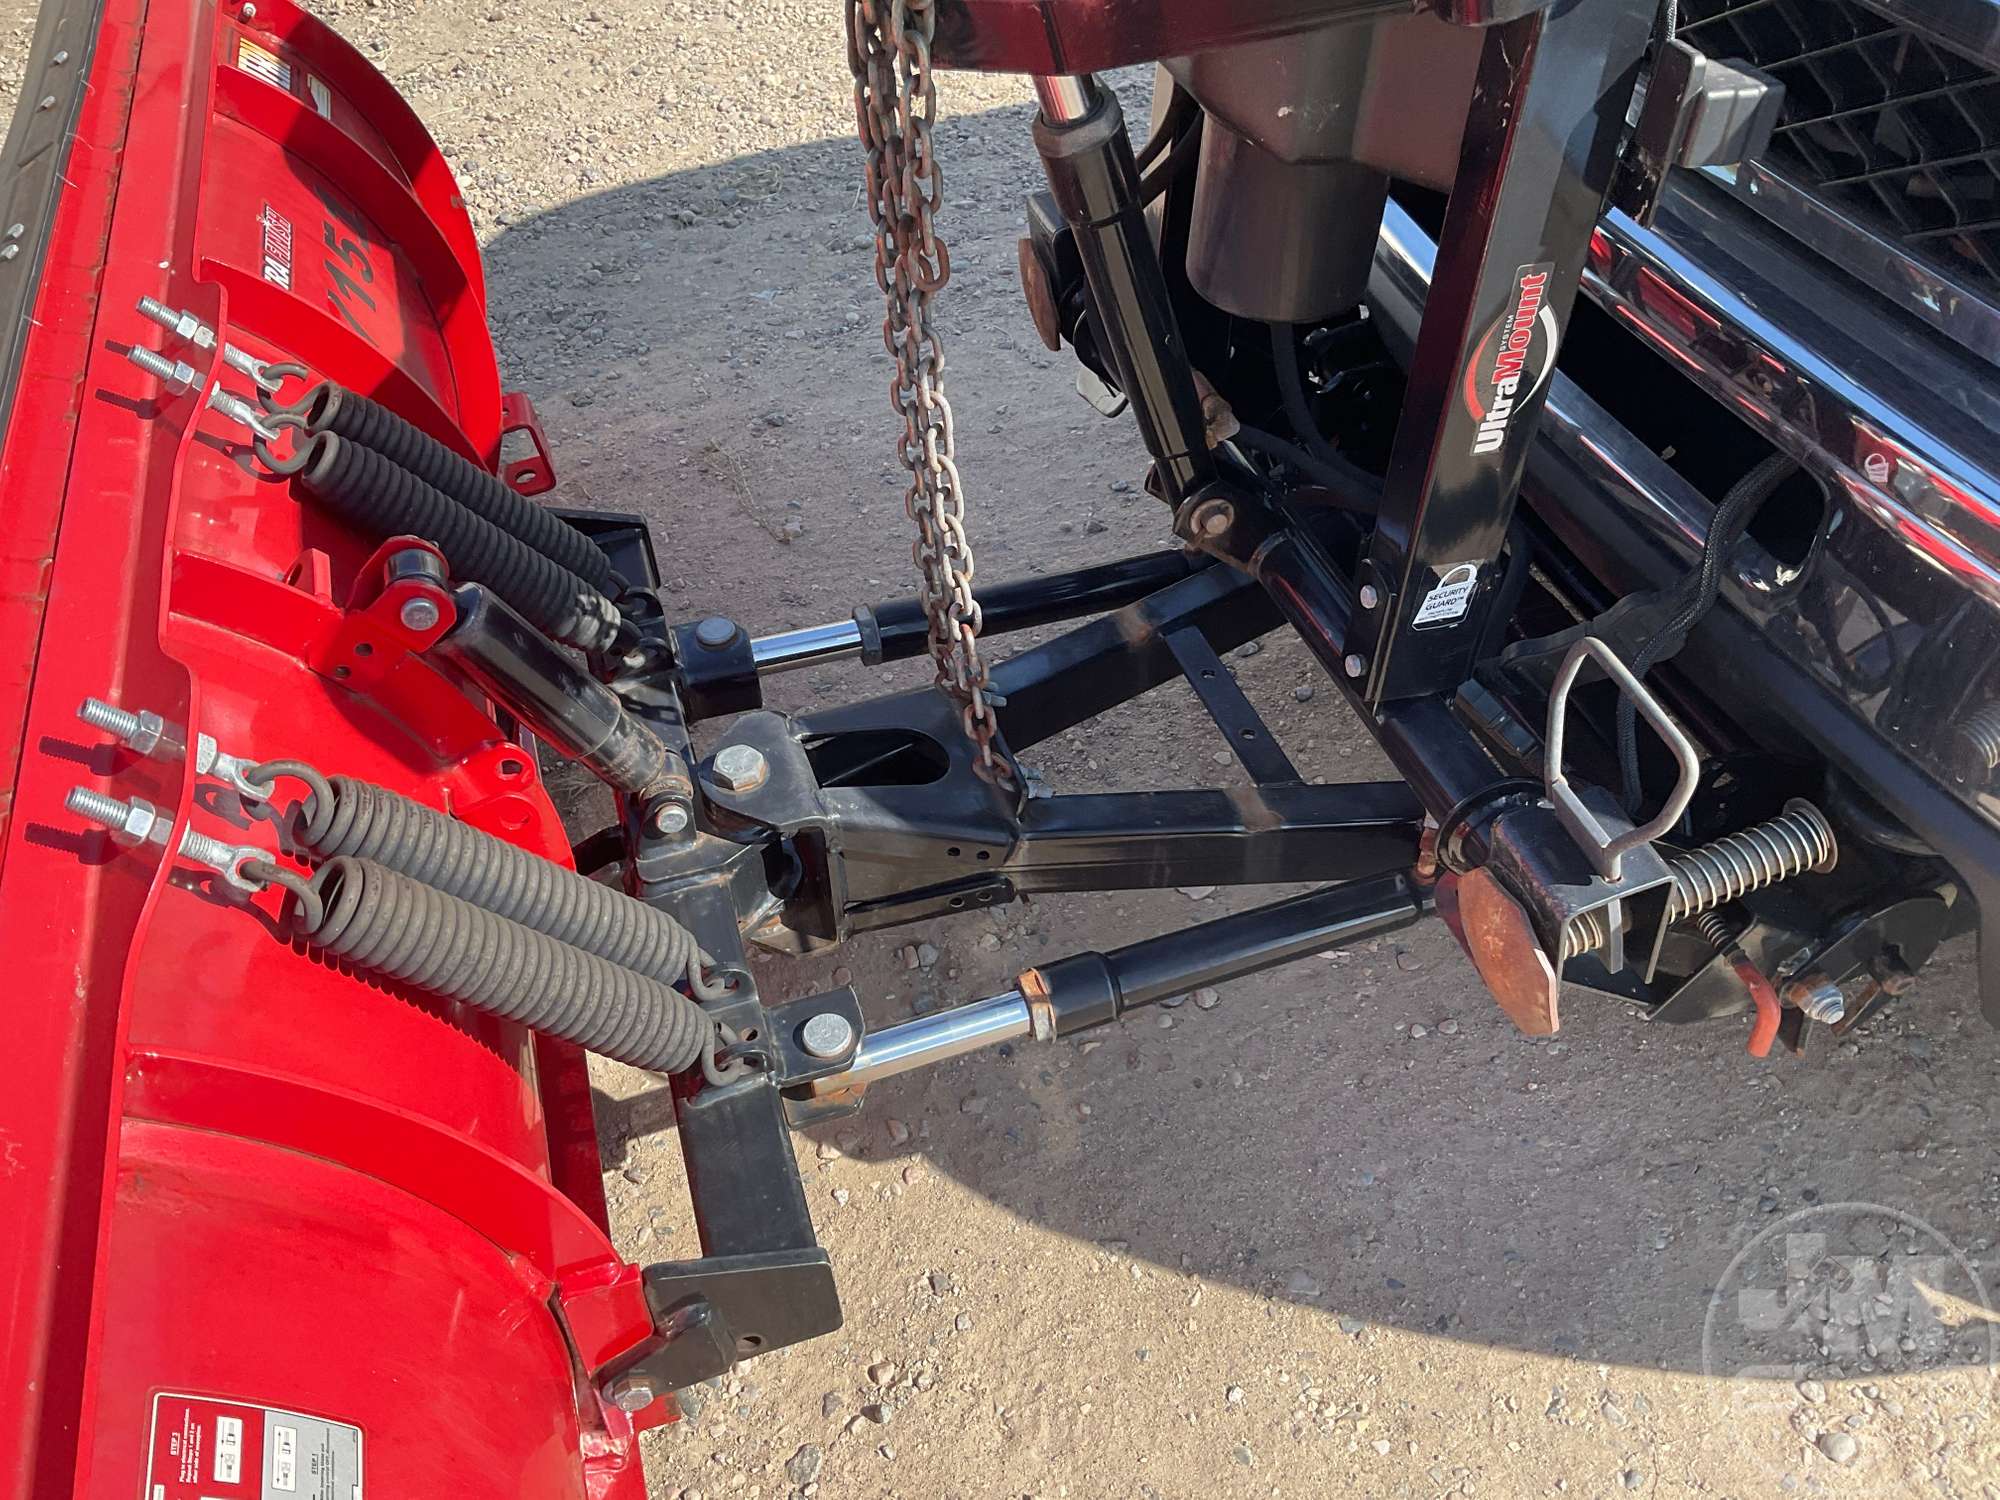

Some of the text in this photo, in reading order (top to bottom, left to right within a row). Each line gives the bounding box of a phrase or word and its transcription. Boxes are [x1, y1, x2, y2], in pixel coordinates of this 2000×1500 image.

[1499, 315, 1514, 351] SYSTEM
[1474, 271, 1548, 453] UltraMount
[1427, 586, 1468, 603] SECURITY
